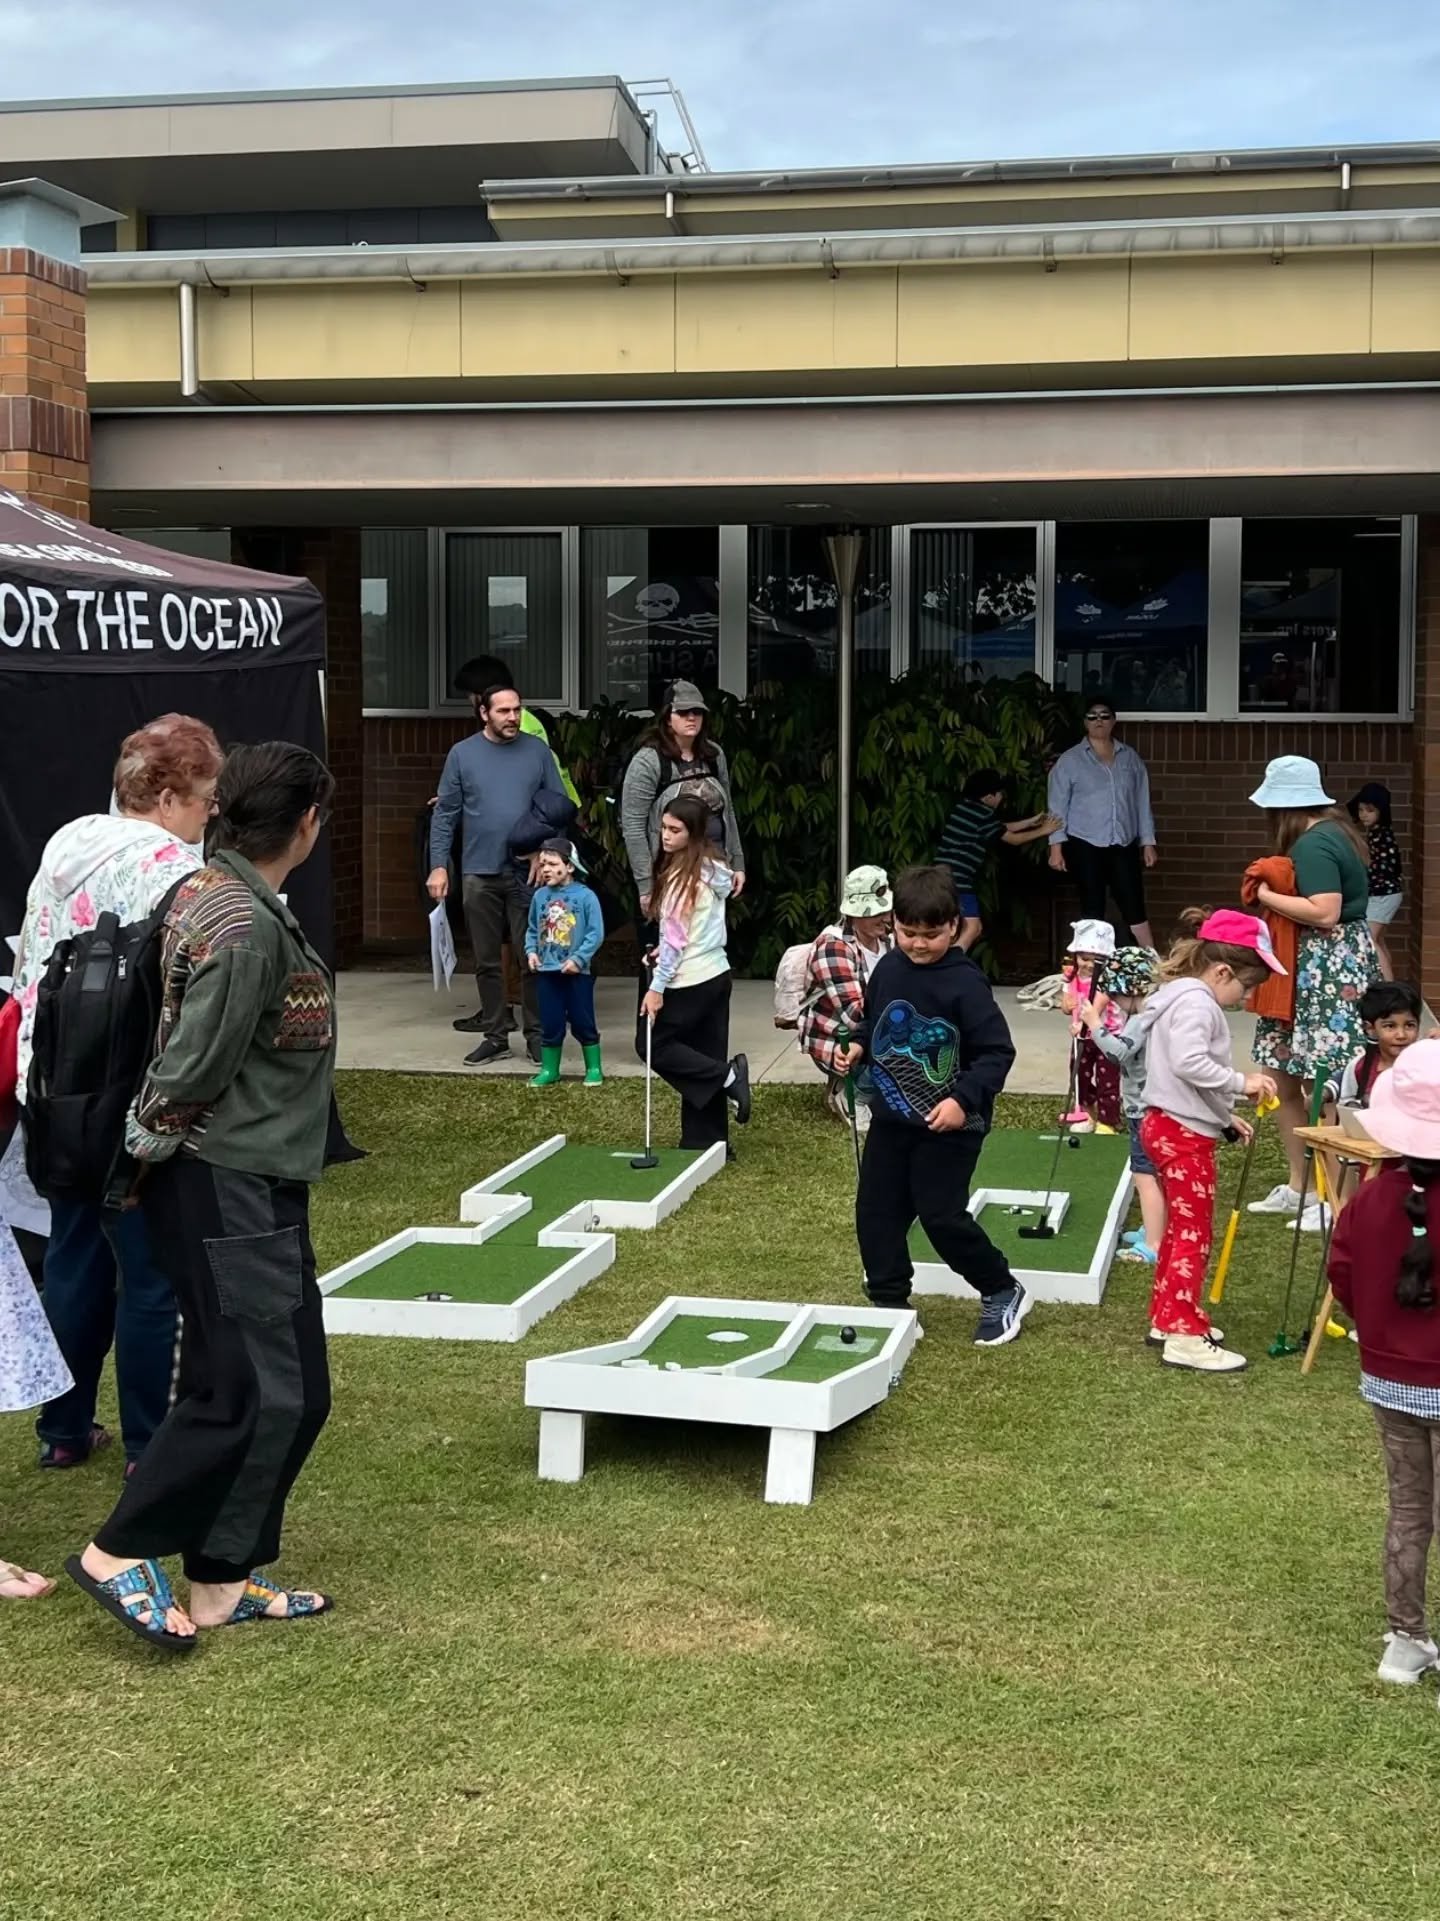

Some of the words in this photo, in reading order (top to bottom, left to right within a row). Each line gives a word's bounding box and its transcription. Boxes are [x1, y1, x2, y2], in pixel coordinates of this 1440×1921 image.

[66, 590, 154, 650] THE
[160, 592, 283, 651] OCEAN
[873, 1065, 911, 1118] DIGITAL
